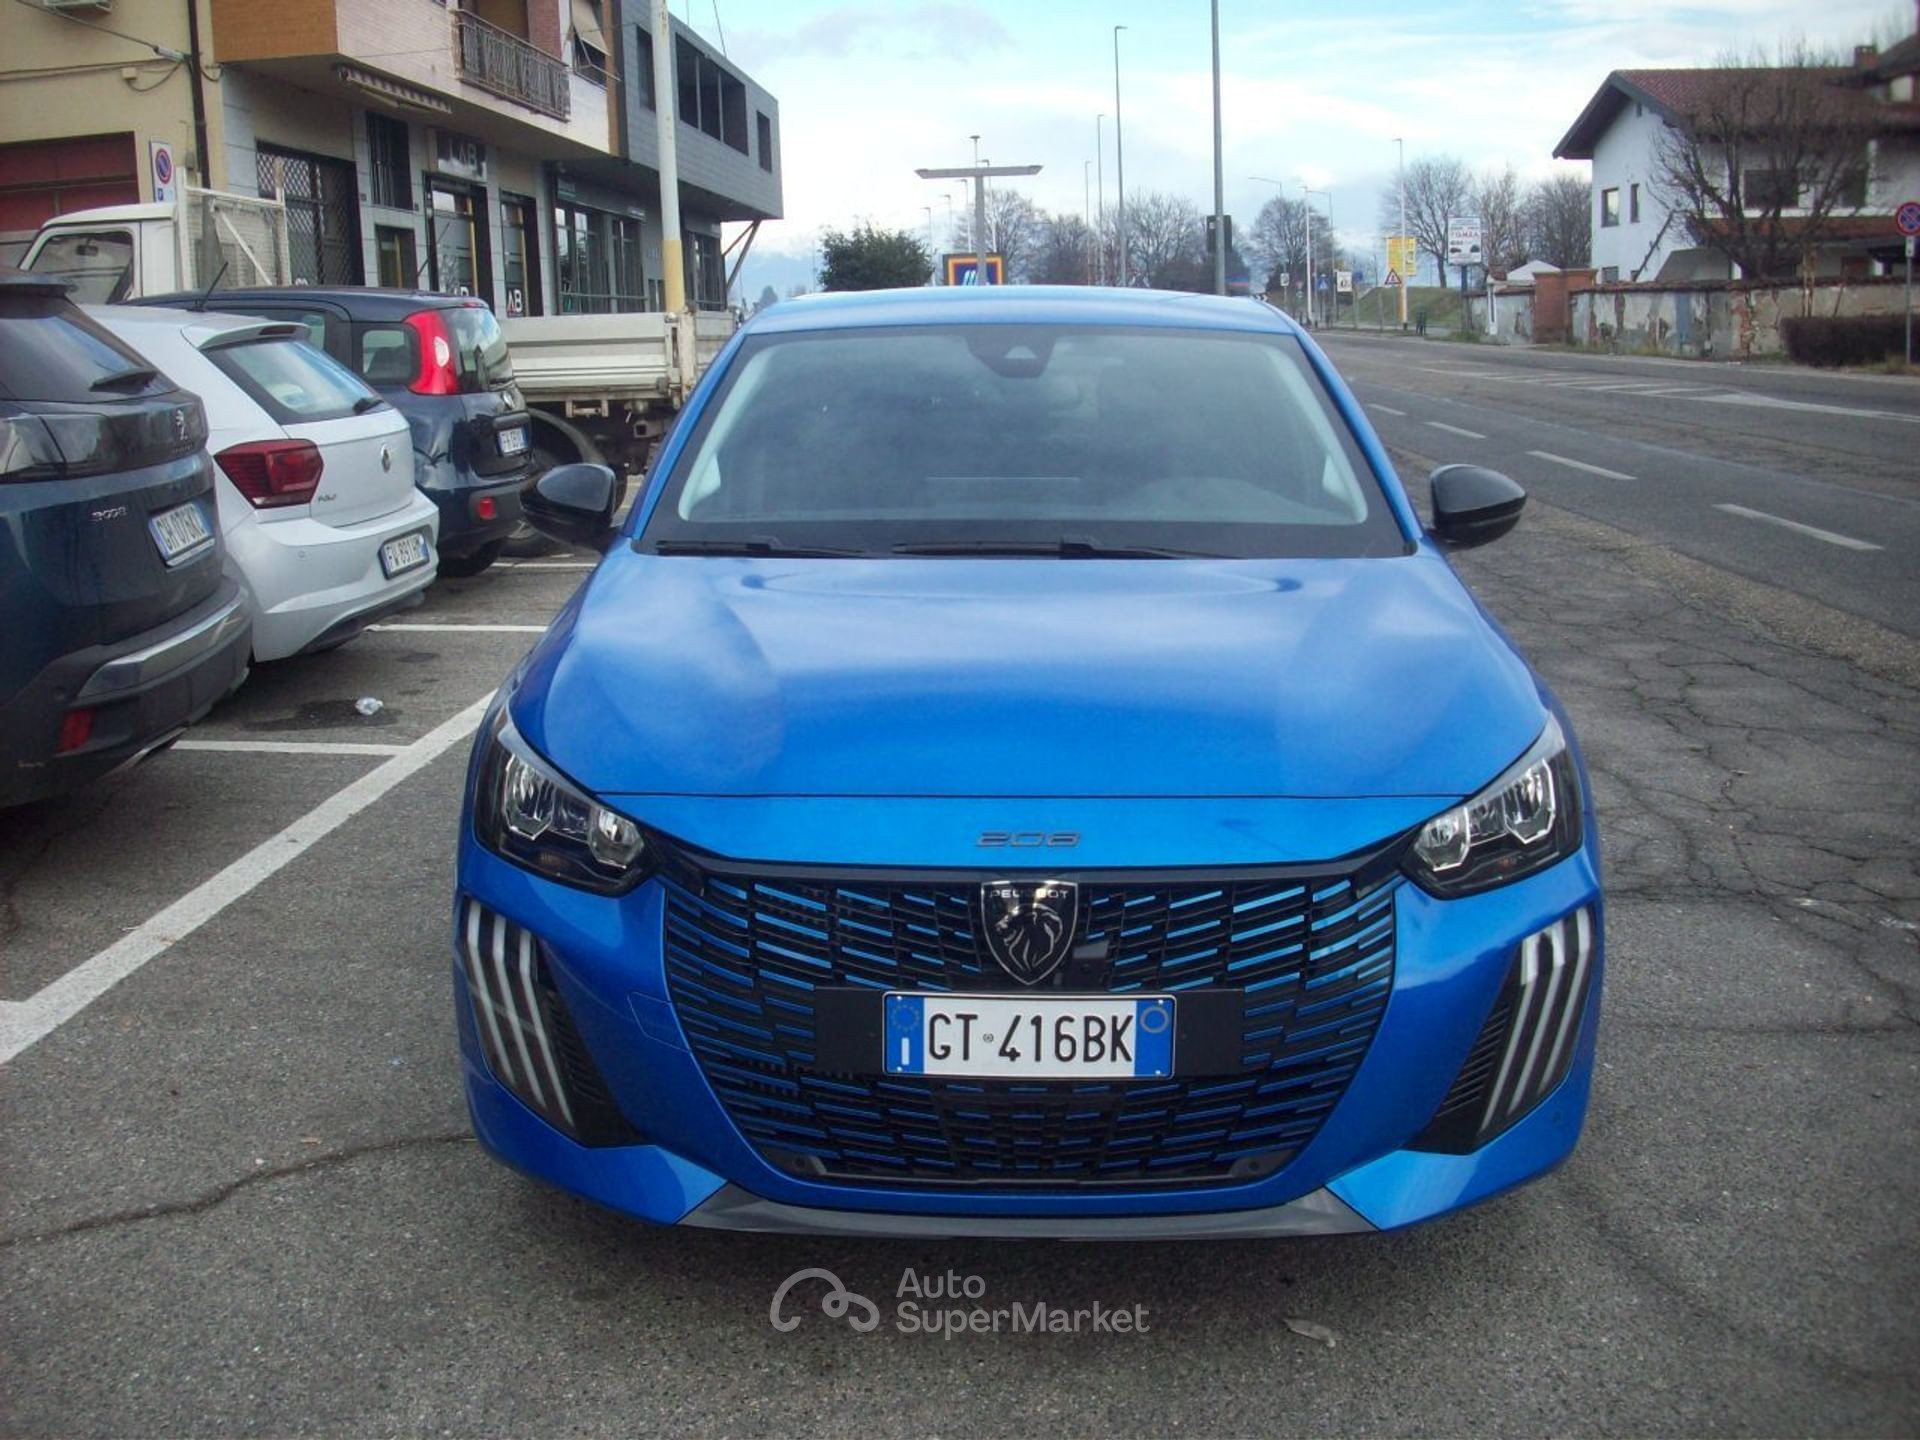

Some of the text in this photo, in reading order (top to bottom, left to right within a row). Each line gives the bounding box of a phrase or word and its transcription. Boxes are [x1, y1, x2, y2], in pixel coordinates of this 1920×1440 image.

[977, 832, 1080, 848] 208
[929, 1013, 1133, 1062] GT 416BK
